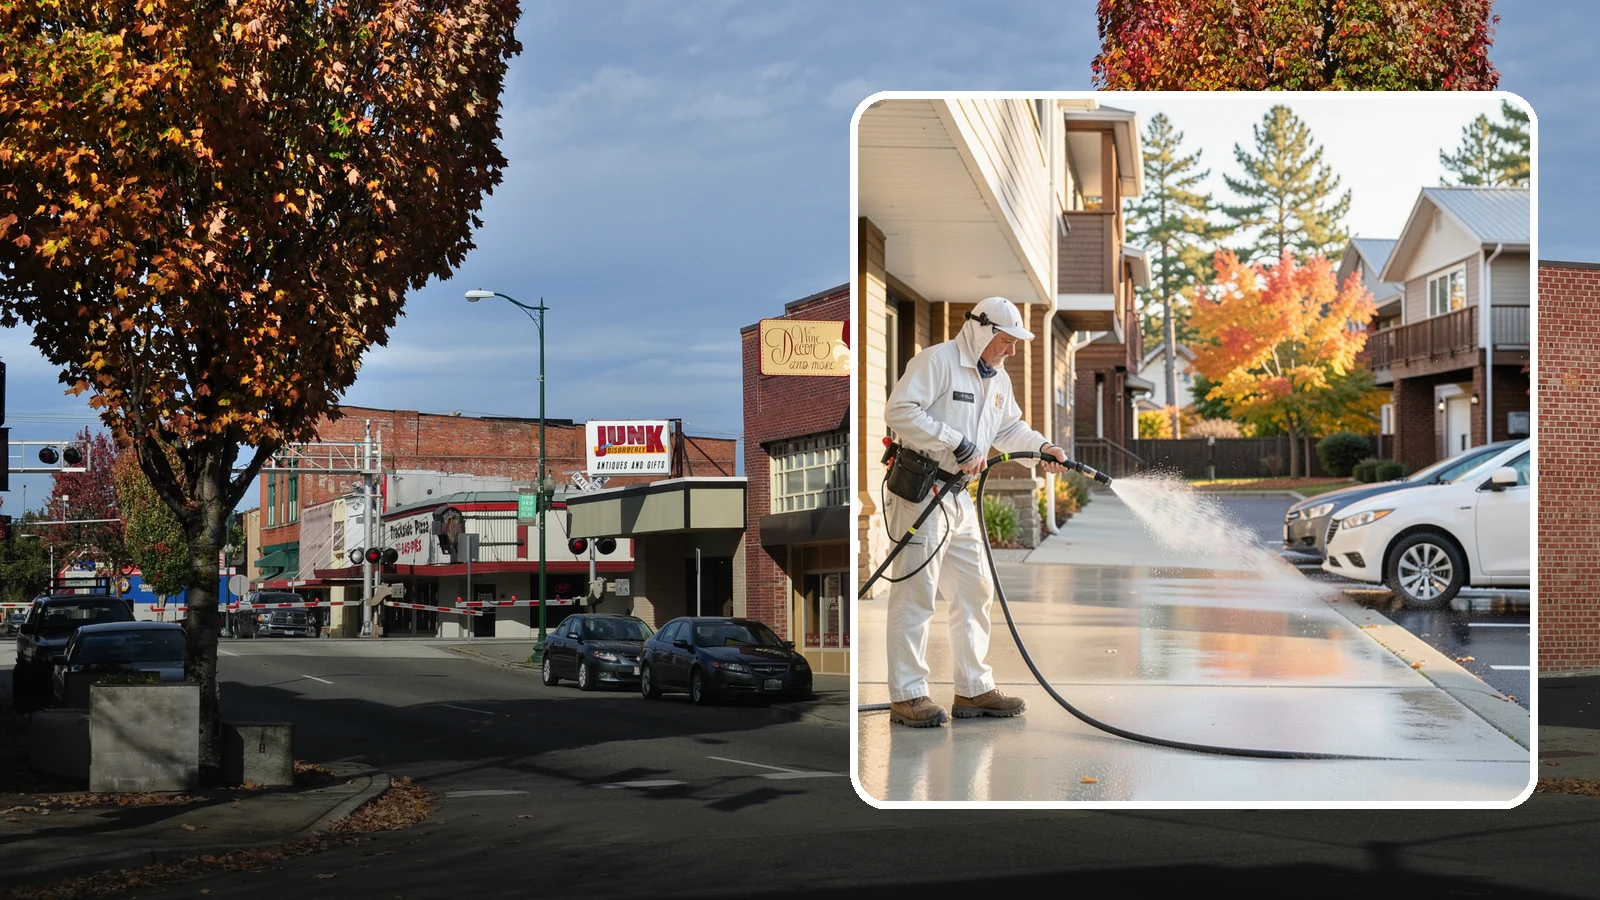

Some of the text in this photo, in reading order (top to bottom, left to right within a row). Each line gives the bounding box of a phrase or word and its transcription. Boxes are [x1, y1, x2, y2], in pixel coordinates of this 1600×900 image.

[765, 328, 831, 365] Decor
[595, 425, 665, 457] JUNK
[607, 446, 645, 454] DISORDERLY
[597, 461, 665, 470] ANTIQUES AND GIFTS
[390, 519, 429, 540] Trackside Pizza
